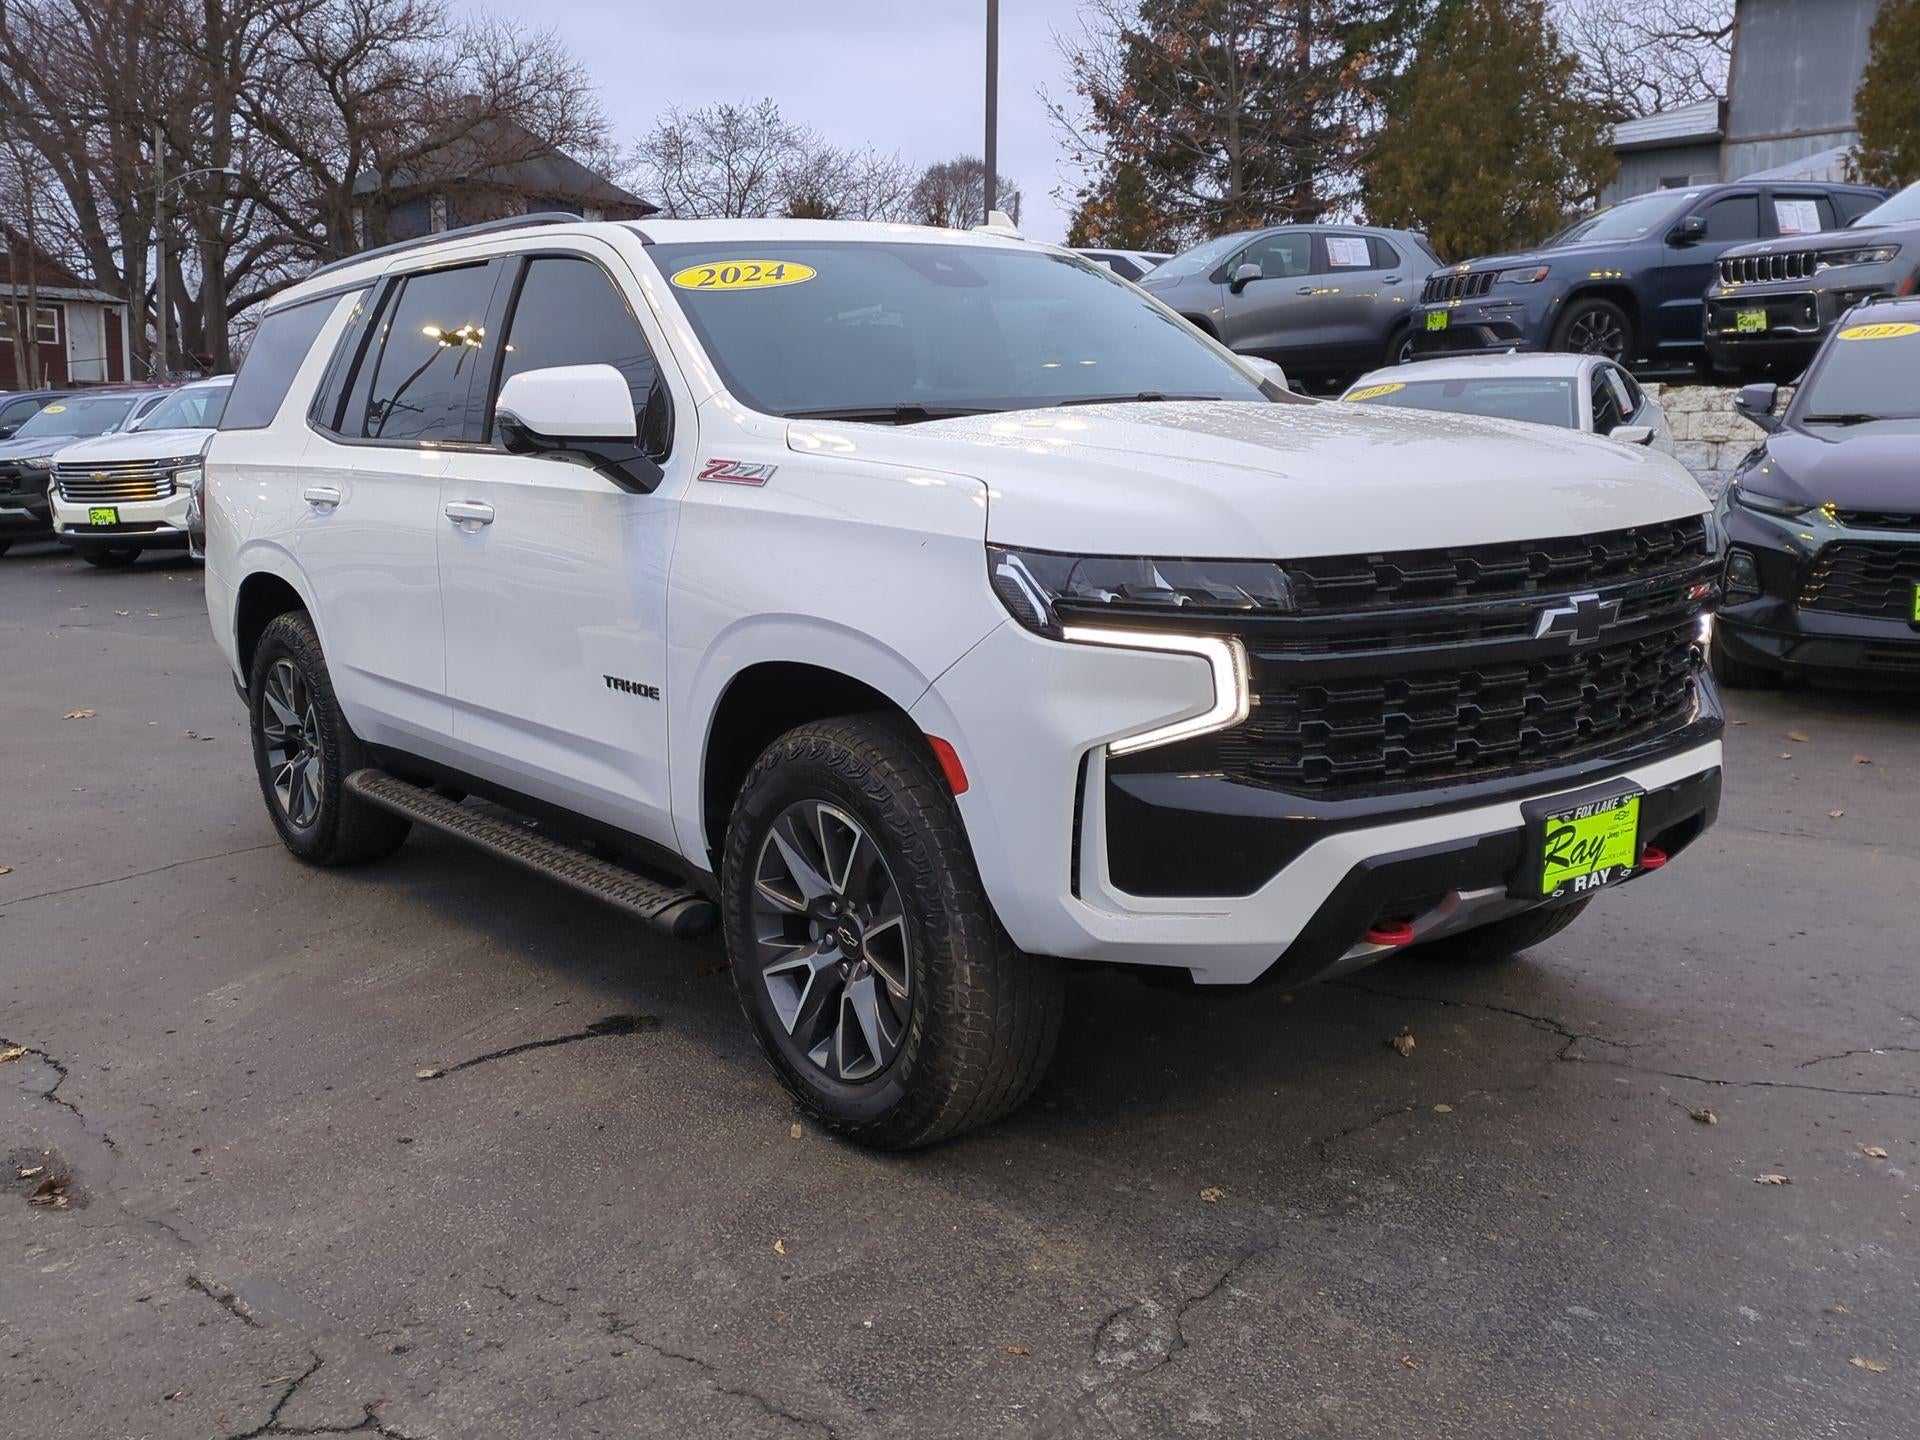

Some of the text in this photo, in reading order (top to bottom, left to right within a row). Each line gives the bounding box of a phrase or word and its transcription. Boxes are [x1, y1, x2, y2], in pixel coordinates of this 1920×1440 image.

[697, 264, 786, 287] 2024
[1848, 326, 1906, 338] 2021
[603, 674, 660, 701] TAHOE
[1574, 803, 1595, 820] FOX
[1595, 797, 1620, 815] LAKE
[1544, 825, 1607, 873] Ray
[1574, 867, 1611, 893] RAY
